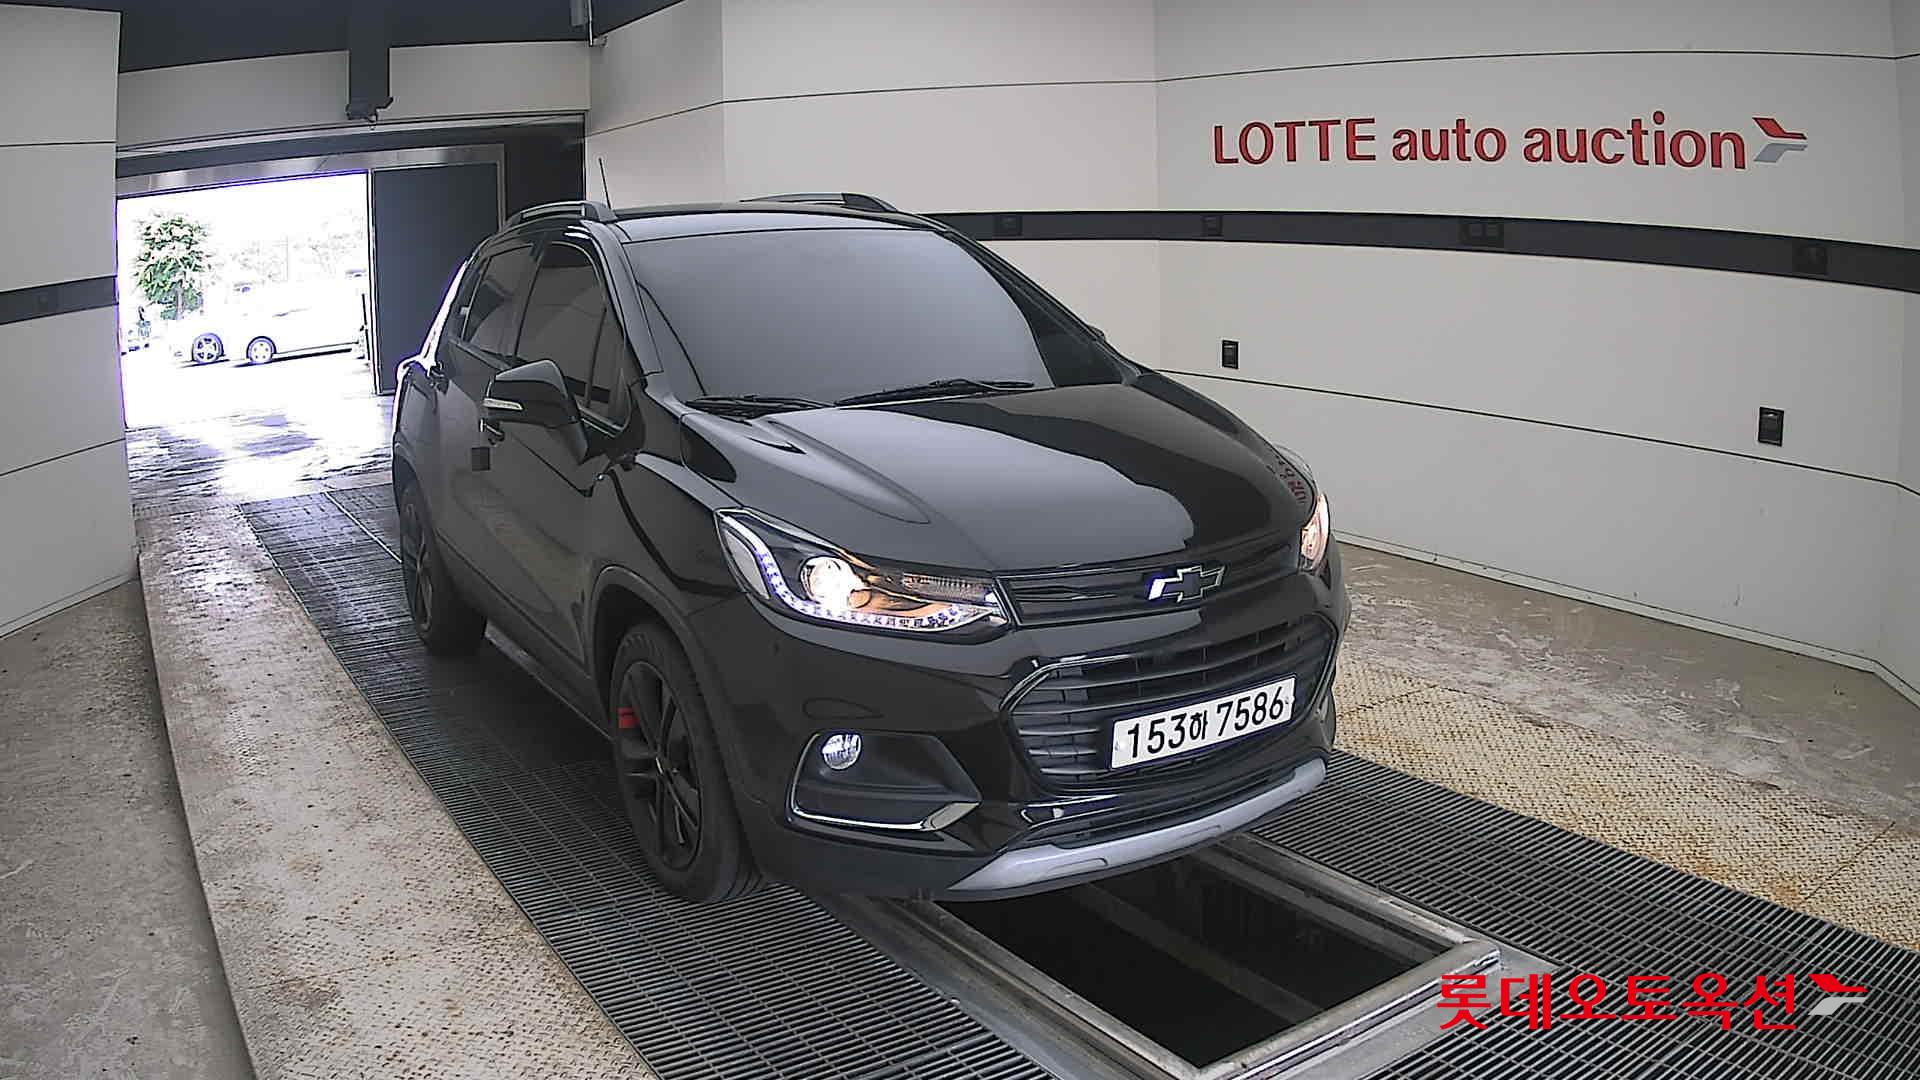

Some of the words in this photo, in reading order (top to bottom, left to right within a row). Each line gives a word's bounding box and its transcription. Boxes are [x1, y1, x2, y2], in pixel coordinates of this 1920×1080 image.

[1213, 118, 1376, 165] LOTTE
[1391, 118, 1507, 163] auto
[1523, 111, 1747, 170] auction
[1127, 710, 1209, 758] 153하
[1216, 686, 1285, 737] 7586
